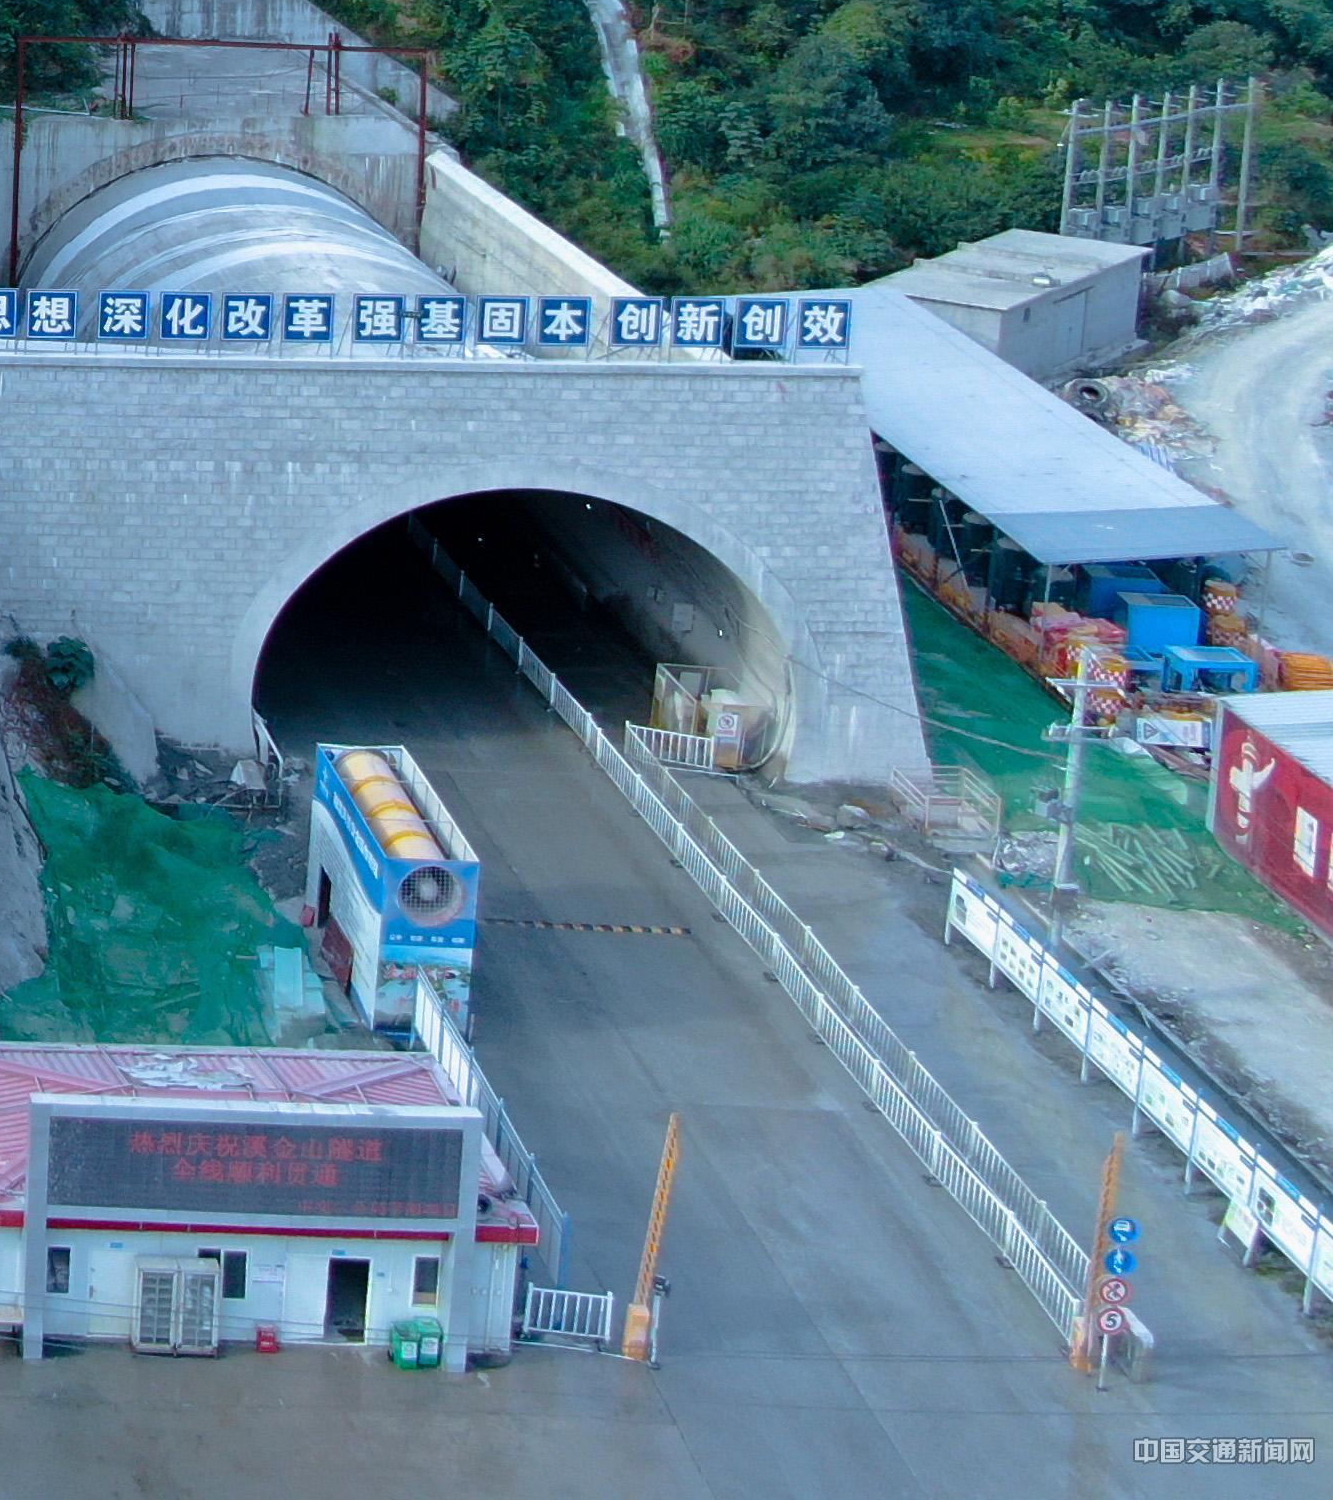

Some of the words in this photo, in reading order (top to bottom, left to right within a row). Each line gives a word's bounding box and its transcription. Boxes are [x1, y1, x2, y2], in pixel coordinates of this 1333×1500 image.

[103, 296, 329, 339] 深化改革
[359, 300, 585, 342] 强基固本
[617, 303, 845, 344] 创新创效
[1106, 1313, 1117, 1328] 5
